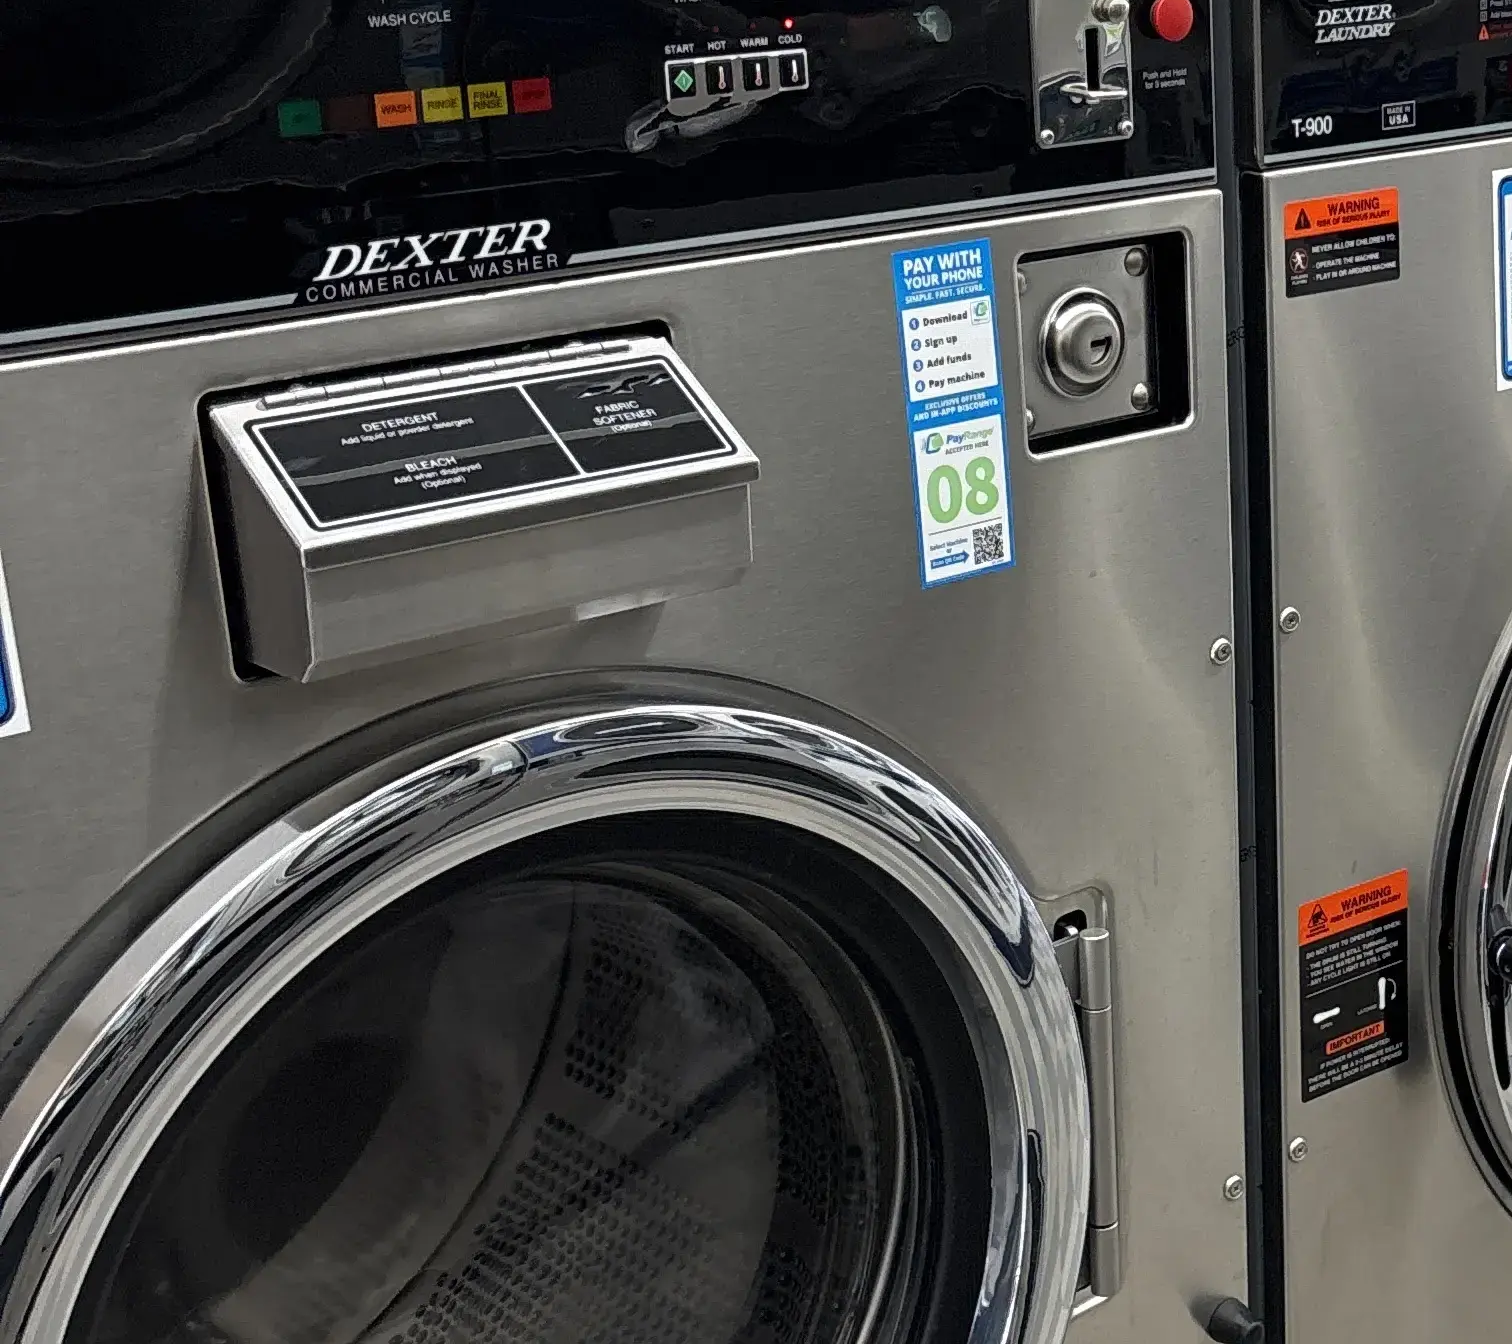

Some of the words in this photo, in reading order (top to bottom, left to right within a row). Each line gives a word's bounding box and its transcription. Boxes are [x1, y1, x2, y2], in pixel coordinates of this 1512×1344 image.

[368, 14, 406, 29] WASH
[409, 9, 452, 25] CYCLE
[1315, 4, 1392, 26] DEXTER
[1315, 22, 1395, 44] LAUNDRY
[665, 43, 694, 55] START
[707, 40, 726, 51] HOT
[740, 37, 768, 48] WARM
[778, 34, 802, 44] COLD
[1291, 115, 1333, 138] T-900
[1327, 197, 1380, 214] WARNING
[312, 218, 551, 282] DEXTER
[903, 255, 935, 276] PAY
[936, 248, 981, 271] WITH
[305, 267, 459, 303] COMMERCIAL
[468, 254, 559, 278] WASHER
[904, 273, 939, 290] YOUR
[942, 266, 983, 284] PHONE
[592, 407, 658, 427] SOFTENER
[594, 400, 640, 415] FABRIC
[362, 412, 438, 433] DETERGENT
[405, 456, 457, 473] BLEACH
[927, 456, 999, 524] 08
[1341, 885, 1392, 911] WARNING
[1329, 1025, 1381, 1052] IMPORTANT
